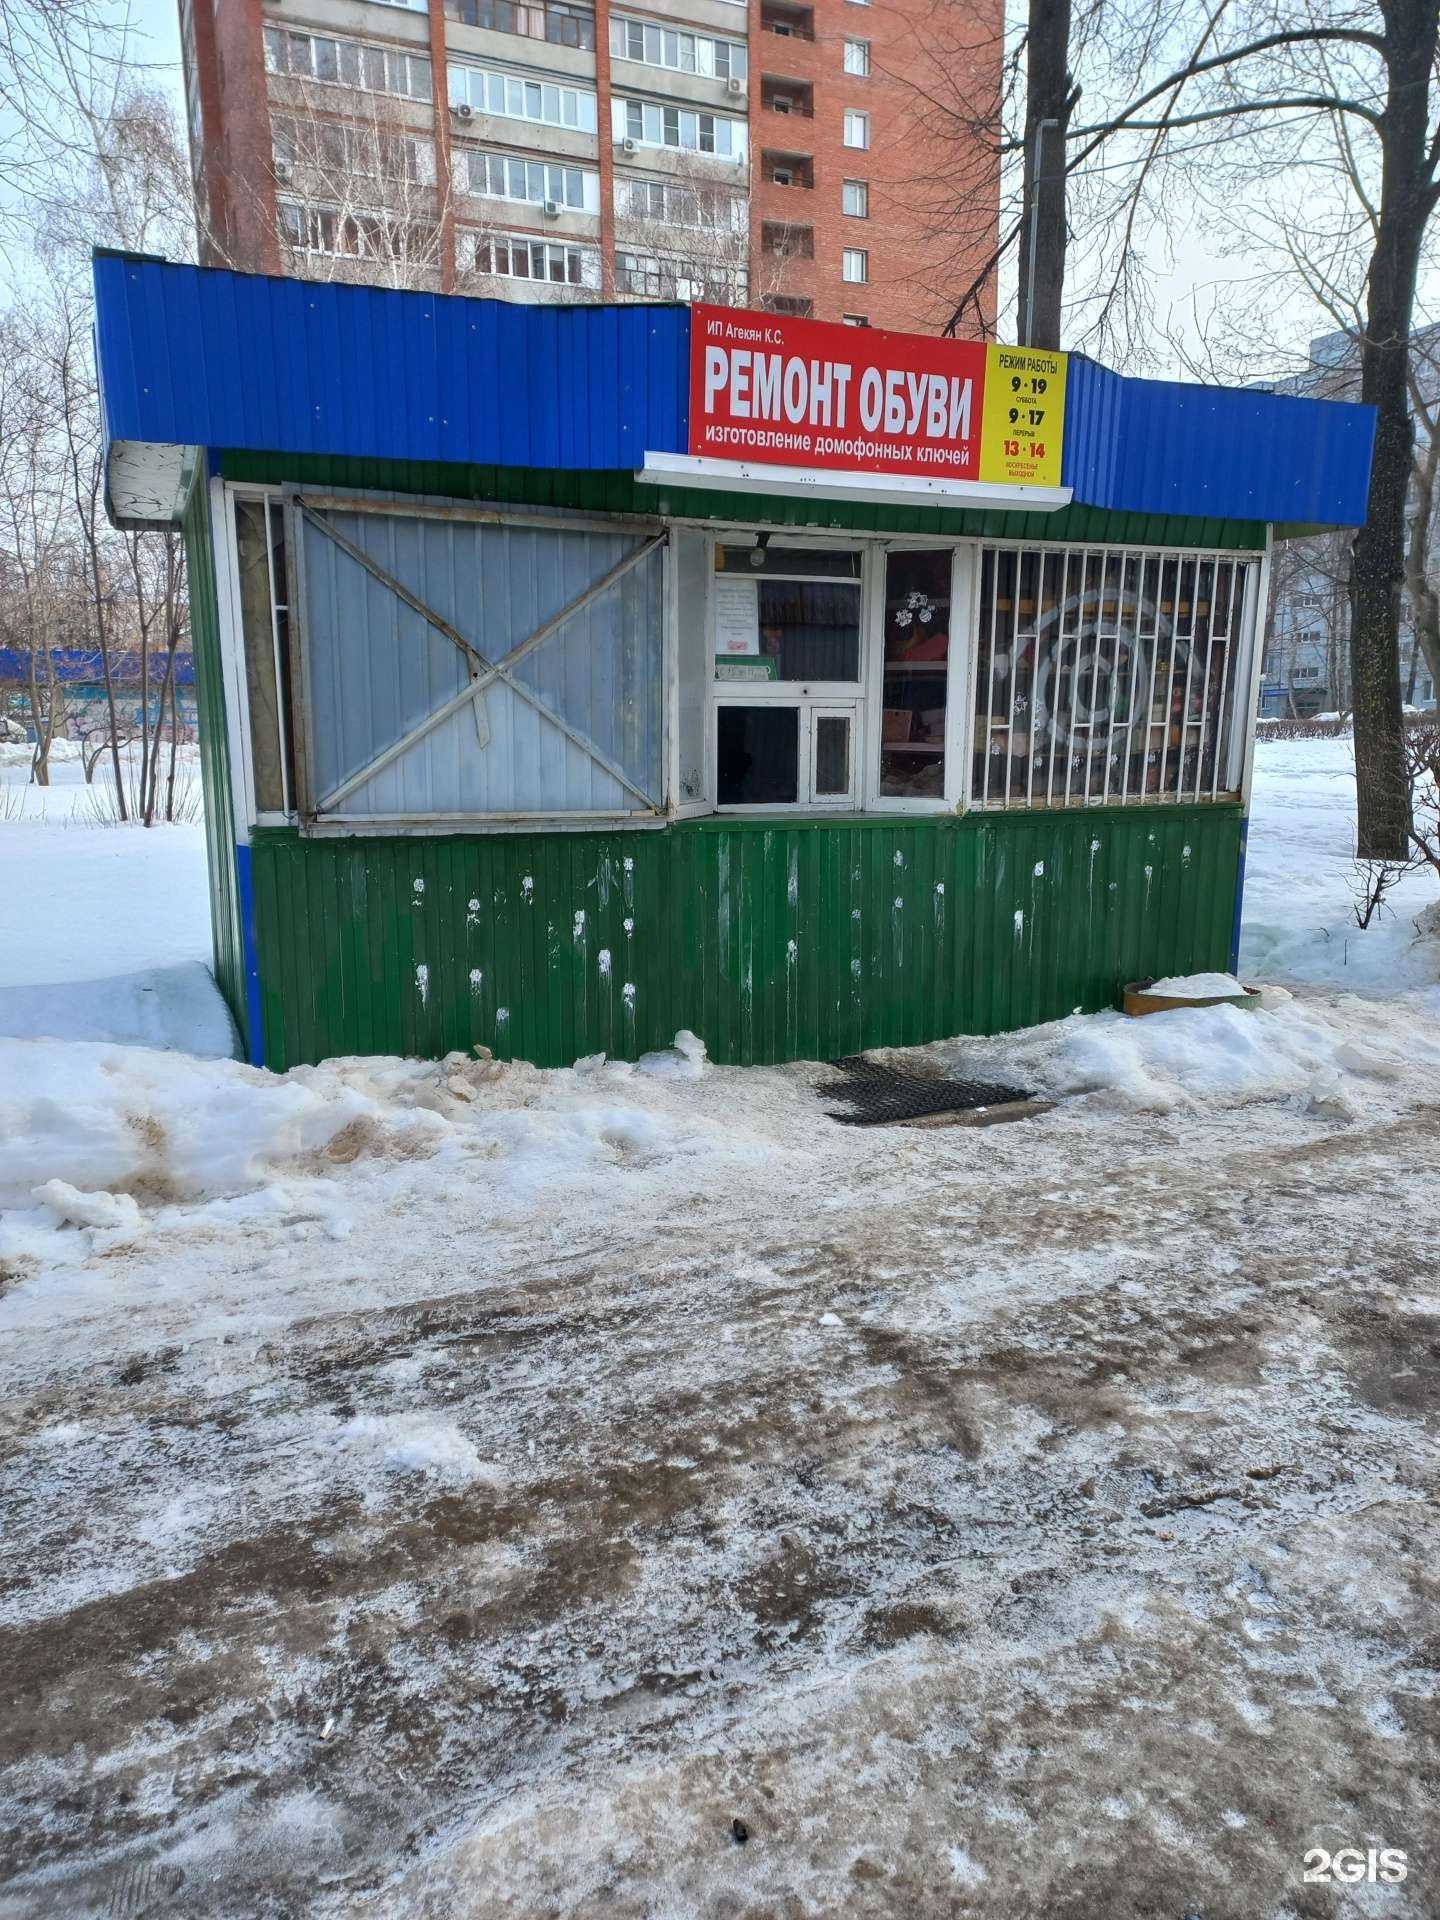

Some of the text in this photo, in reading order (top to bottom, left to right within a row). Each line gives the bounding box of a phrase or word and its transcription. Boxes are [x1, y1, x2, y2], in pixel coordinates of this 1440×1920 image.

[707, 319, 784, 345] ИП Агекян К.С.
[999, 354, 1058, 375] РЕЖИМ РАБОТЫ
[704, 345, 973, 441] РЕМОНТ ОБУВИ
[705, 424, 970, 466] изготовление домофонных ключей
